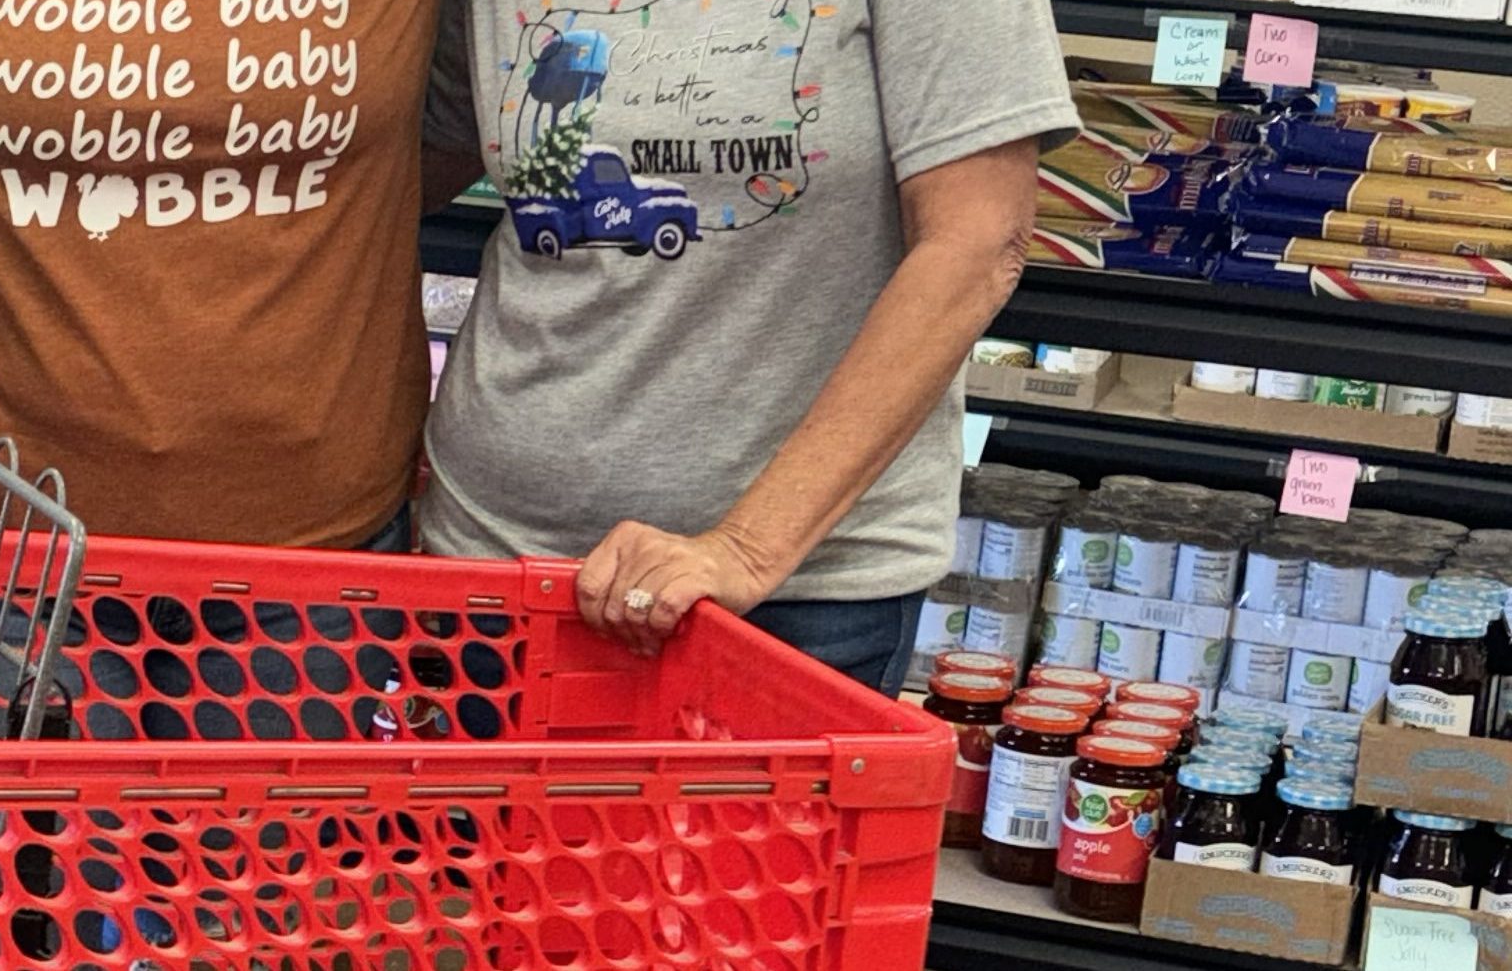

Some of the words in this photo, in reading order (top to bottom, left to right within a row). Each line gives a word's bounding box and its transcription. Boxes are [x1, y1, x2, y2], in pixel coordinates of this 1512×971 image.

[1170, 21, 1219, 40] Cream
[1261, 23, 1287, 42] Two
[608, 25, 769, 76] Christmas
[226, 28, 358, 97] baby
[624, 90, 643, 105] is
[654, 73, 717, 116] better
[225, 94, 359, 157] baby
[696, 114, 730, 126] in
[740, 115, 765, 125] a
[630, 138, 701, 175] SMALL
[711, 134, 793, 173] TOWN
[1300, 455, 1328, 475] Two
[1424, 713, 1456, 726] FREE
[1074, 837, 1111, 854] apple
